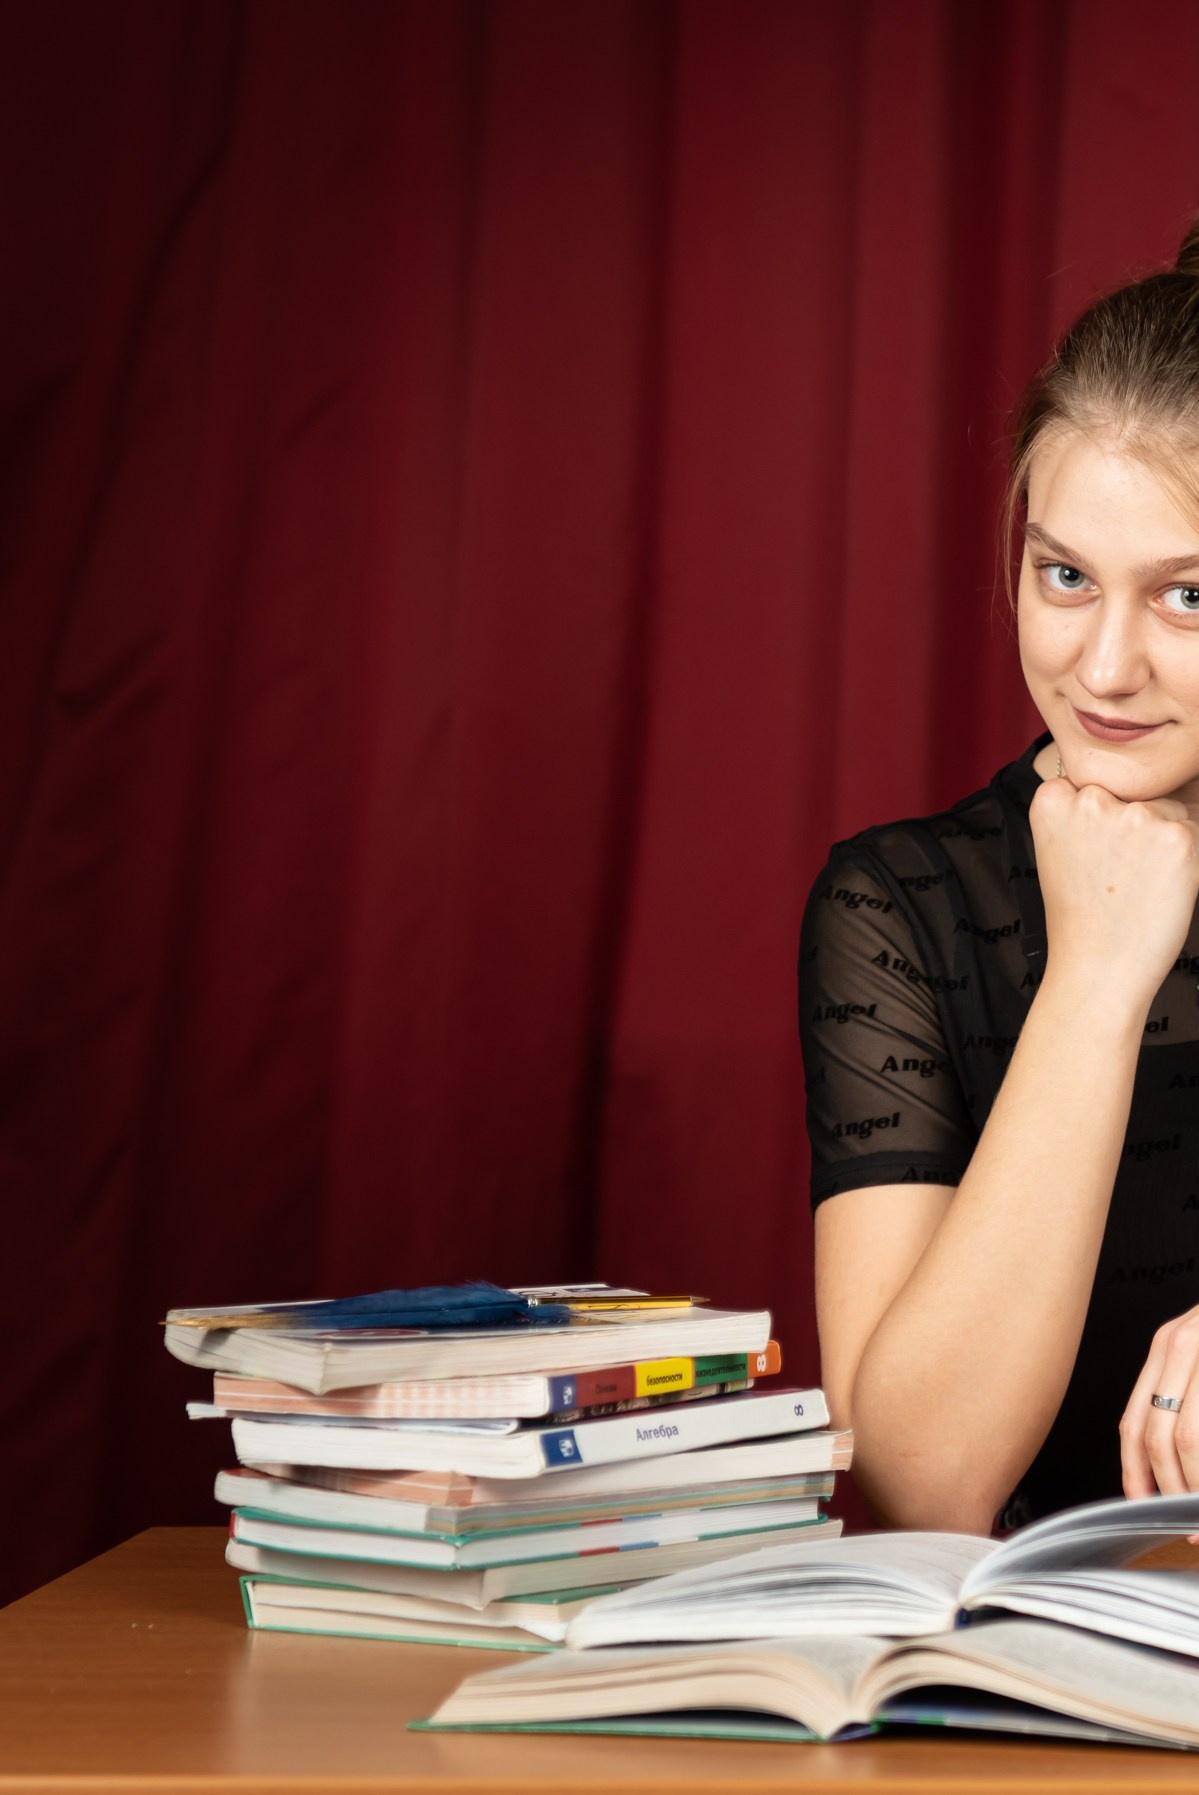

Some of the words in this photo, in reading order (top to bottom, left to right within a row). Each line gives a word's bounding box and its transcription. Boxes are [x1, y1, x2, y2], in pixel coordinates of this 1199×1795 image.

[820, 884, 893, 914] Angel
[954, 917, 1021, 944] Angel
[872, 950, 922, 985] Ang
[813, 1003, 877, 1024] Angel
[881, 1055, 955, 1078] Ange
[831, 1112, 900, 1139] Angel
[1122, 1134, 1181, 1162] ngel
[1108, 1257, 1195, 1284] Angel
[757, 1354, 767, 1372] 8
[635, 1423, 680, 1442] Алгебра
[794, 1404, 804, 1417] 8
